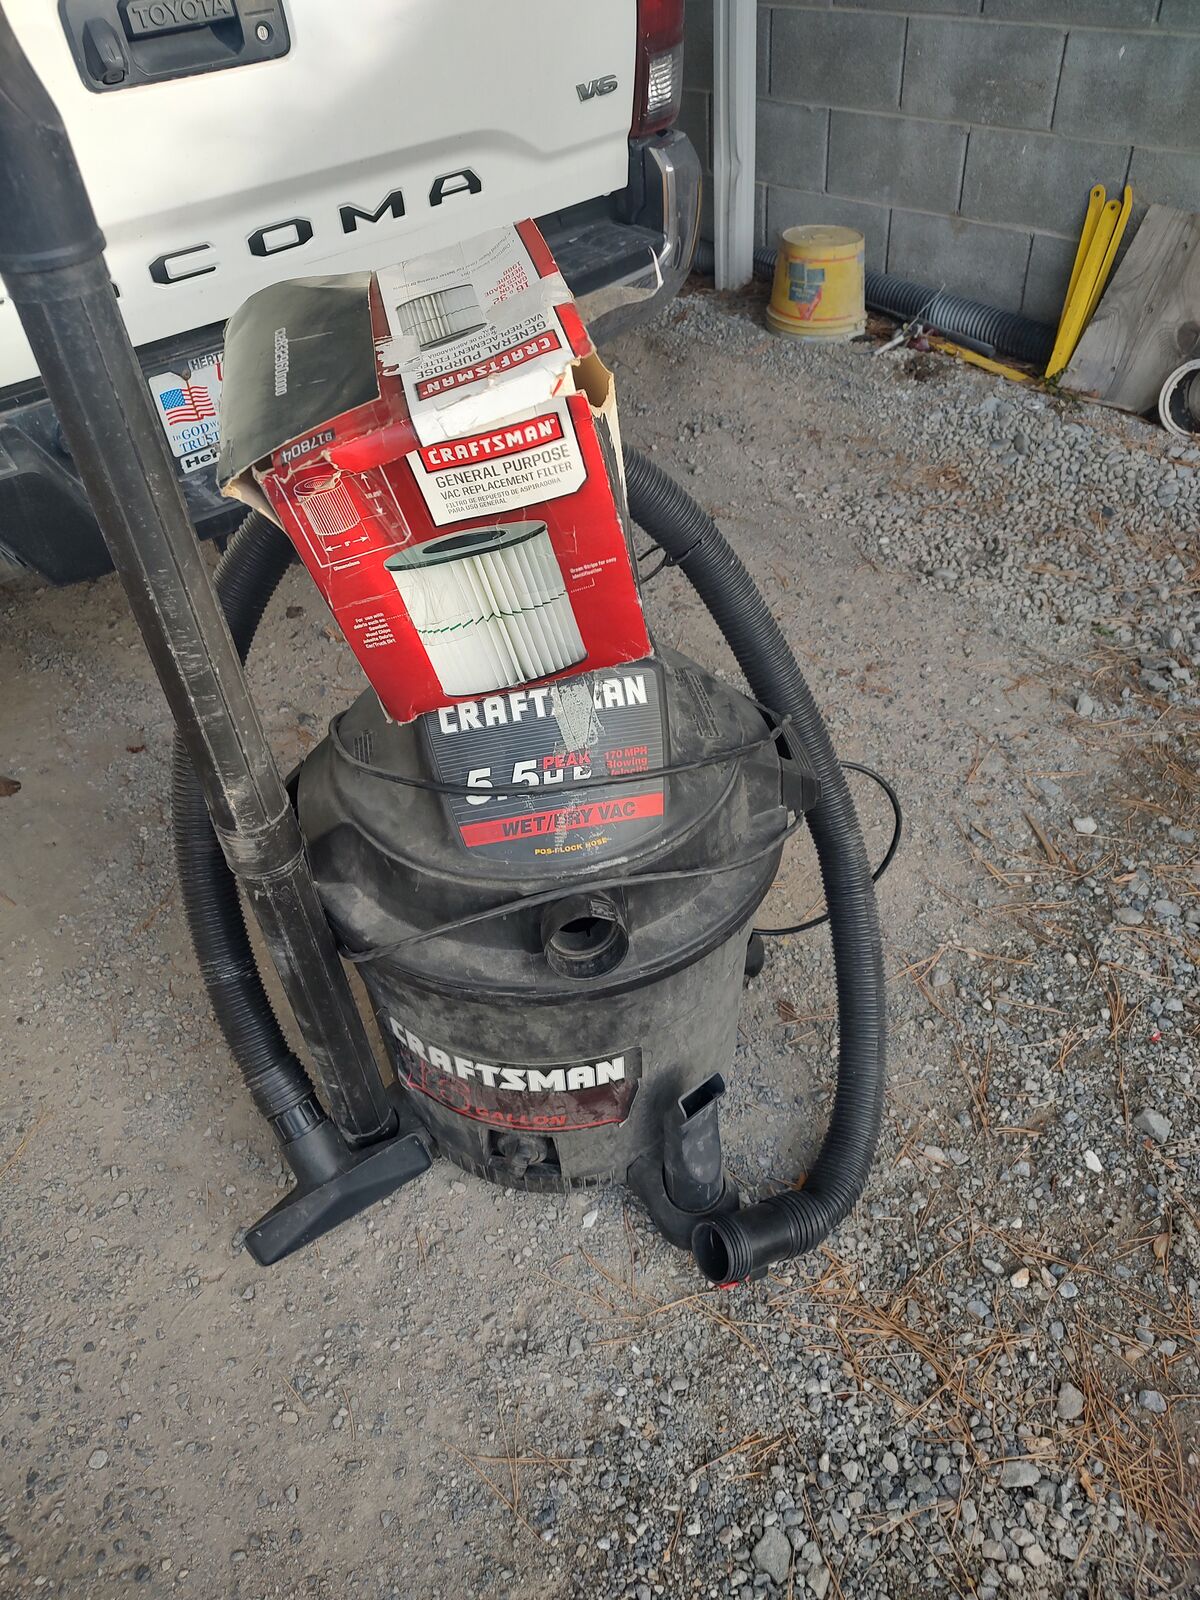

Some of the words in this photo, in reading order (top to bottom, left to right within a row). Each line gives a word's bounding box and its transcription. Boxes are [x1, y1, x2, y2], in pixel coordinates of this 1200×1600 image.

[132, 0, 229, 29] TOYOTA
[576, 74, 618, 102] V6
[497, 266, 524, 285] BEFORE
[499, 275, 528, 295] GALLON
[507, 271, 526, 284] VACS
[524, 312, 544, 326] VAC
[453, 322, 523, 357] REPLACEMENT
[483, 321, 546, 353] GENERAL
[416, 352, 482, 380] PURPOSE
[181, 421, 210, 441] GOD
[179, 431, 220, 453] TRUST
[427, 421, 552, 465] CRAFTSMAN
[435, 465, 501, 489] GENERAL
[502, 444, 571, 474] PURPOSE
[440, 488, 461, 501] VAC
[463, 473, 535, 496] REPLACEMENT
[537, 461, 573, 479] FILTER
[445, 499, 468, 510] FILTRO
[477, 490, 510, 503] REPUESTO
[520, 477, 561, 493] ASPIRADORA
[448, 506, 465, 515] PARA
[466, 503, 479, 512] USO
[479, 497, 507, 509] GENERAL
[438, 674, 649, 735] CRAFTAN
[543, 751, 591, 770] PEAK
[604, 750, 623, 760] 170
[624, 745, 648, 757] MPH
[606, 757, 648, 769] Blowing
[597, 801, 636, 820] VAC
[585, 836, 609, 849] HOSE
[389, 1016, 626, 1092] CRAFTSMAN
[475, 1108, 568, 1126] GALLON
